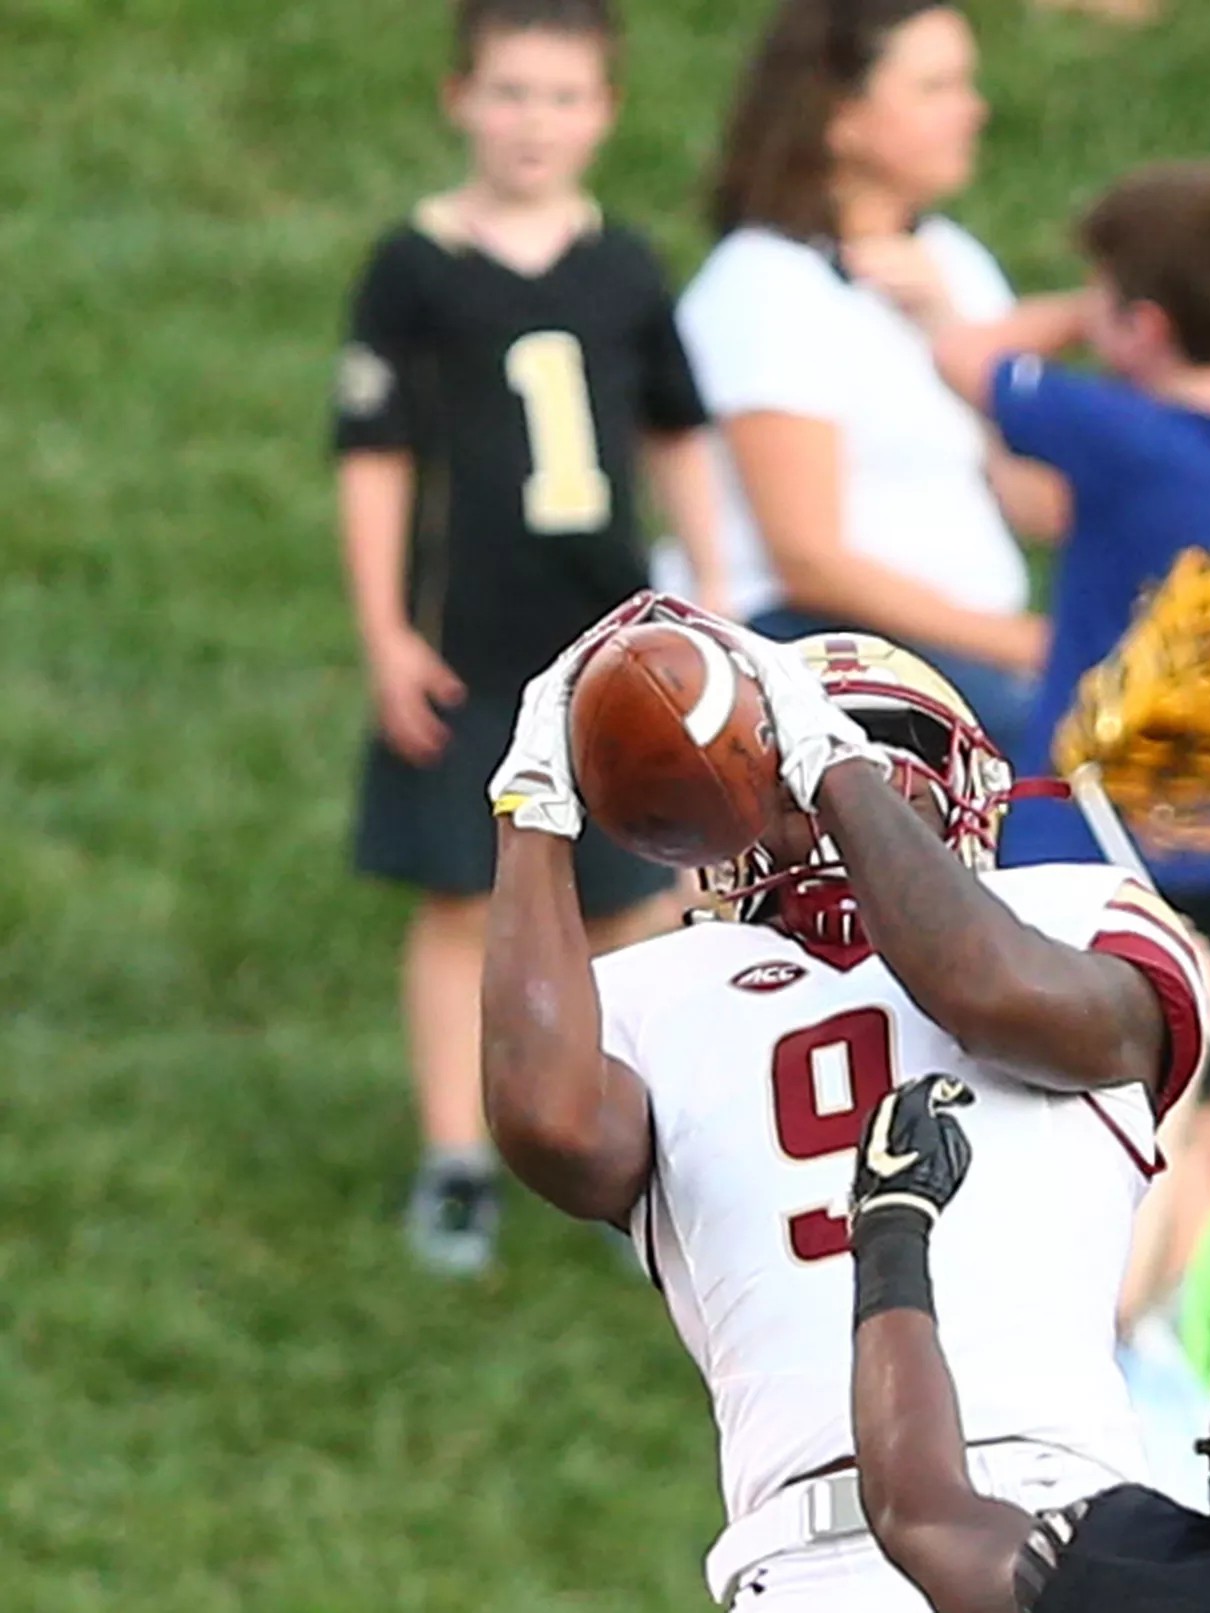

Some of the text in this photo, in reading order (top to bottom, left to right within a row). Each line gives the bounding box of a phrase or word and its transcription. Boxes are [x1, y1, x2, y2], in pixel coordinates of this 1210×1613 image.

[505, 330, 611, 534] 1
[736, 965, 798, 985] ACC
[769, 1004, 898, 1264] 9
